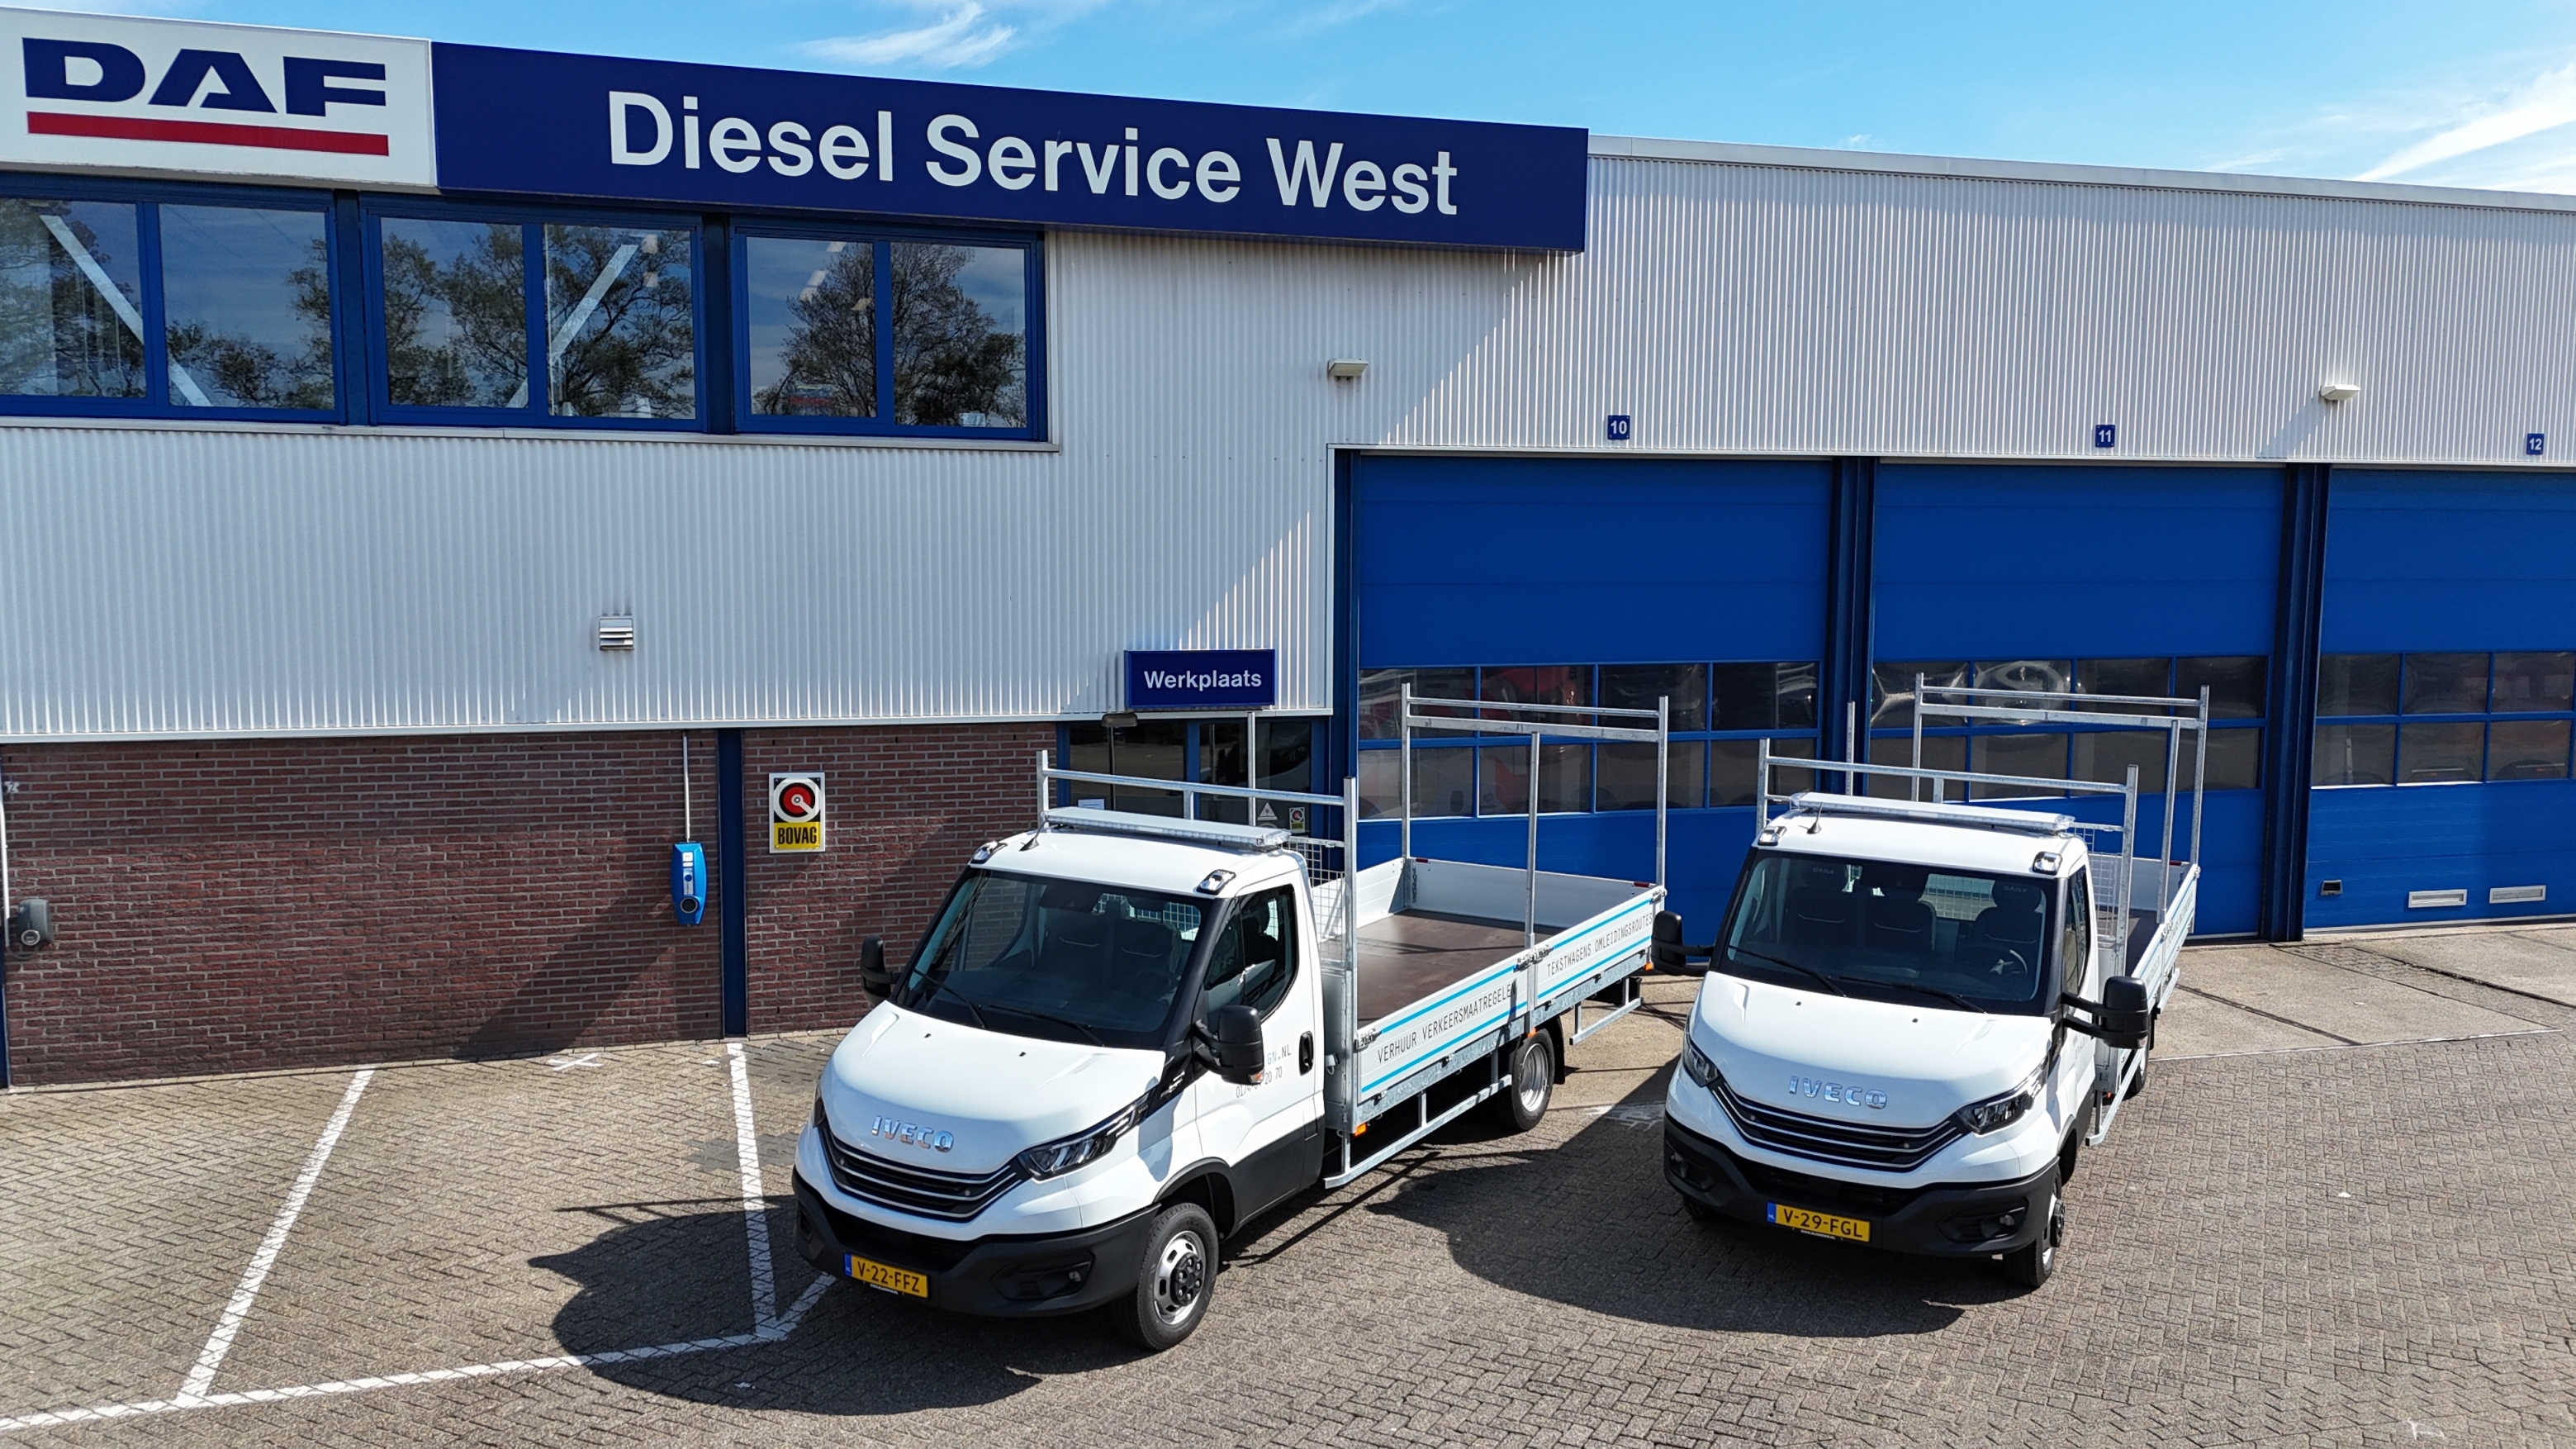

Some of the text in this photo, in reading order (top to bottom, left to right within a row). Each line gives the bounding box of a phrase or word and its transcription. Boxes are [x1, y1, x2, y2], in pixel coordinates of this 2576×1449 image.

[22, 37, 386, 116] DAF
[609, 91, 1457, 215] Diesel Service West
[1611, 420, 1627, 435] 10
[2099, 430, 2111, 443] 11
[2529, 438, 2542, 450] 12
[1144, 670, 1262, 691] Werkplaats
[778, 827, 817, 844] BOVAG
[1547, 913, 1653, 977] TEKSTWAGENS OMLEIDINGSROUTES
[1378, 981, 1516, 1064] VERHUUR VERKEERSMAATREGELEN
[1267, 1044, 1292, 1065] GN.NL
[1789, 1076, 1887, 1109] IVECO
[871, 1115, 954, 1152] IVECO
[1783, 1208, 1863, 1238] V-29-FGL
[857, 1261, 920, 1293] V-22-FFZ
